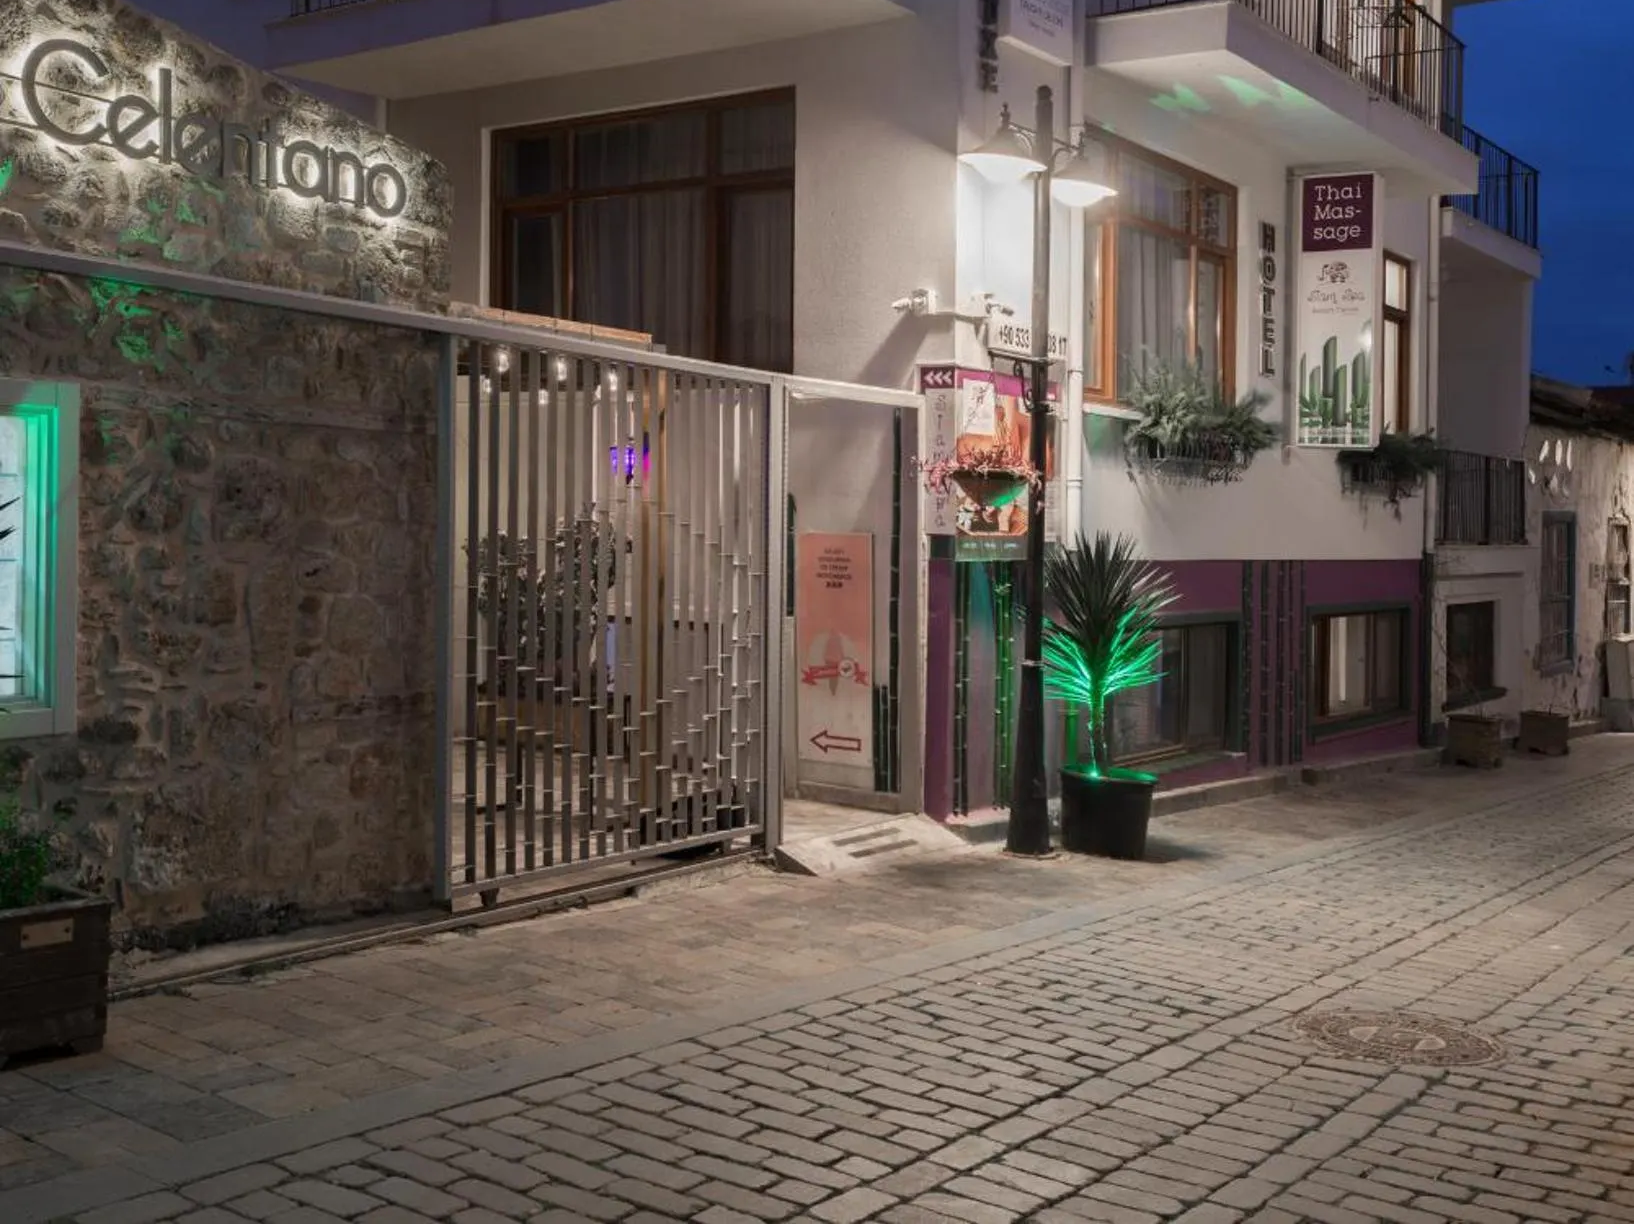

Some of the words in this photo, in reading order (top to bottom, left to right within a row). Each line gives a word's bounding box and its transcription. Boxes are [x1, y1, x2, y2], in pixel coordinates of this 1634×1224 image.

[21, 38, 408, 219] Celentano
[1313, 181, 1363, 202] Thai
[1313, 203, 1362, 221] Mas-
[1313, 225, 1362, 243] sage
[1260, 221, 1276, 376] HOTEL
